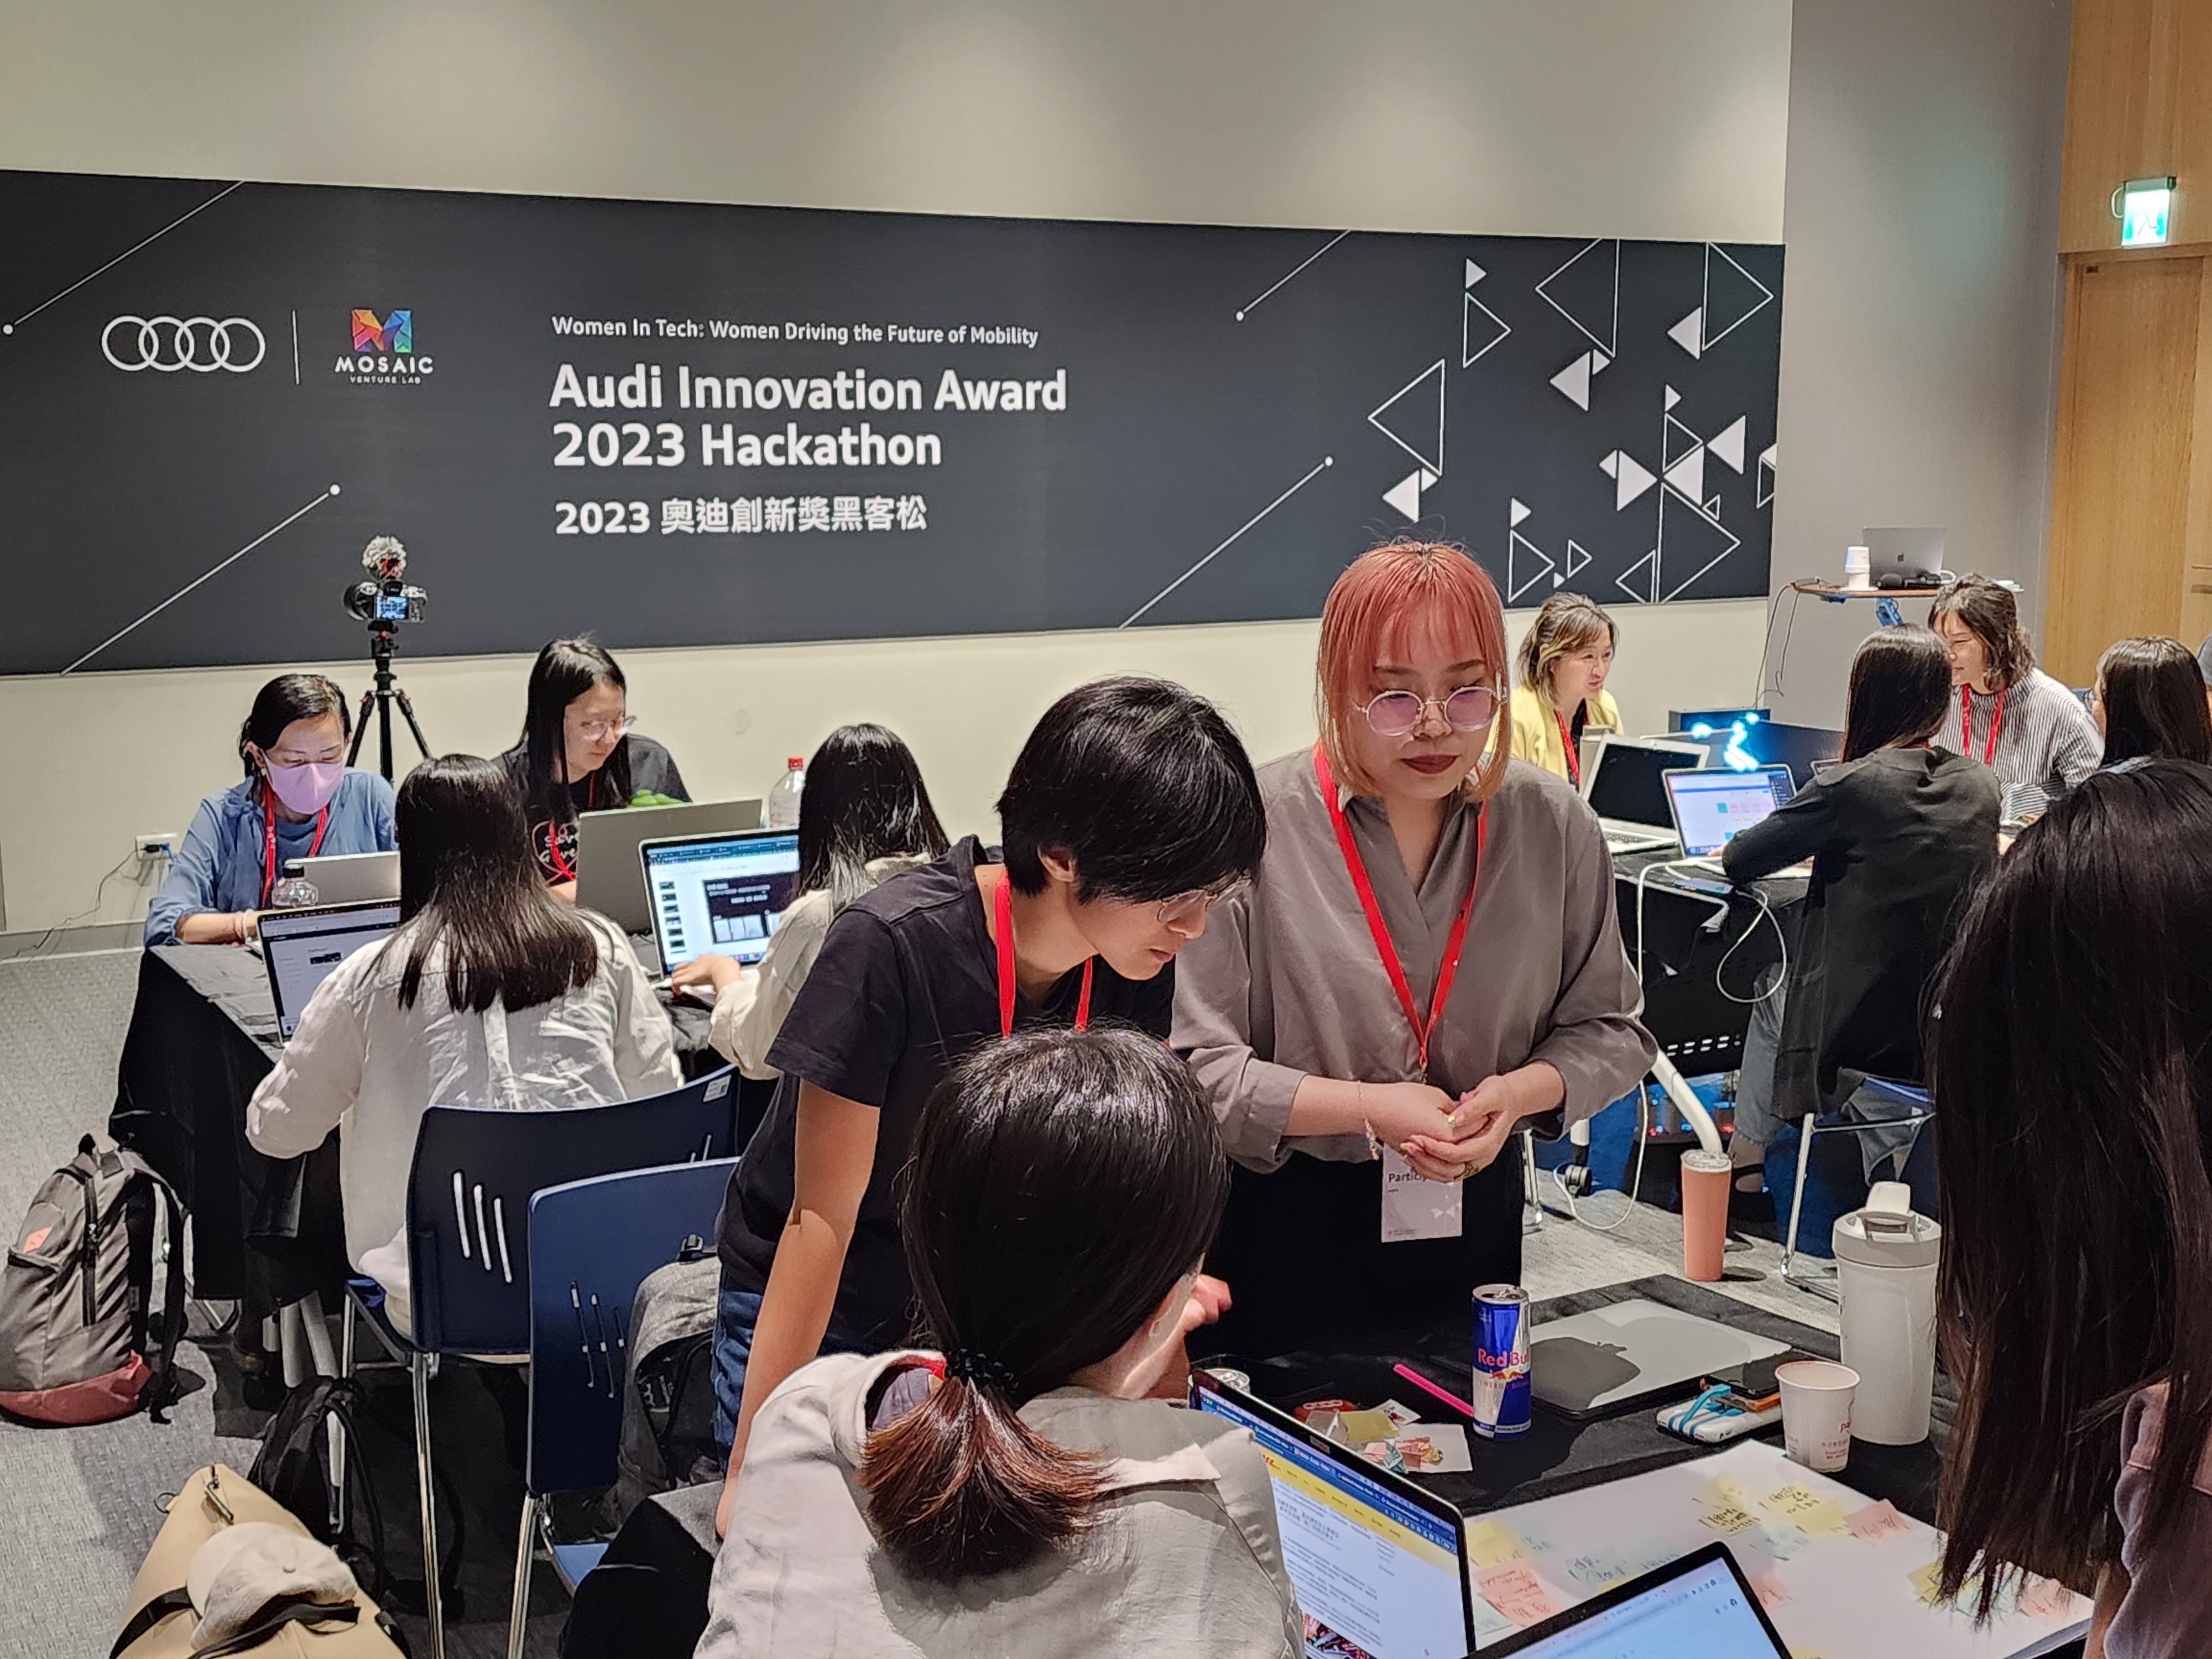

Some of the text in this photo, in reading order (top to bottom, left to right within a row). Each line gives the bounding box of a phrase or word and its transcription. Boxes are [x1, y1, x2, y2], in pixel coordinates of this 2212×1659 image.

[552, 316, 1039, 348] Women In Tech: Women Driving the Future of Mobility
[335, 356, 434, 374] MOSAIC
[349, 375, 397, 384] VENTURE
[549, 363, 1066, 411] Audi Innovation Award
[554, 422, 941, 467] 2023 Hackathon
[555, 495, 927, 535] 2023 奧迪創新獎黑客松
[1478, 1346, 1531, 1367] Red Bul
